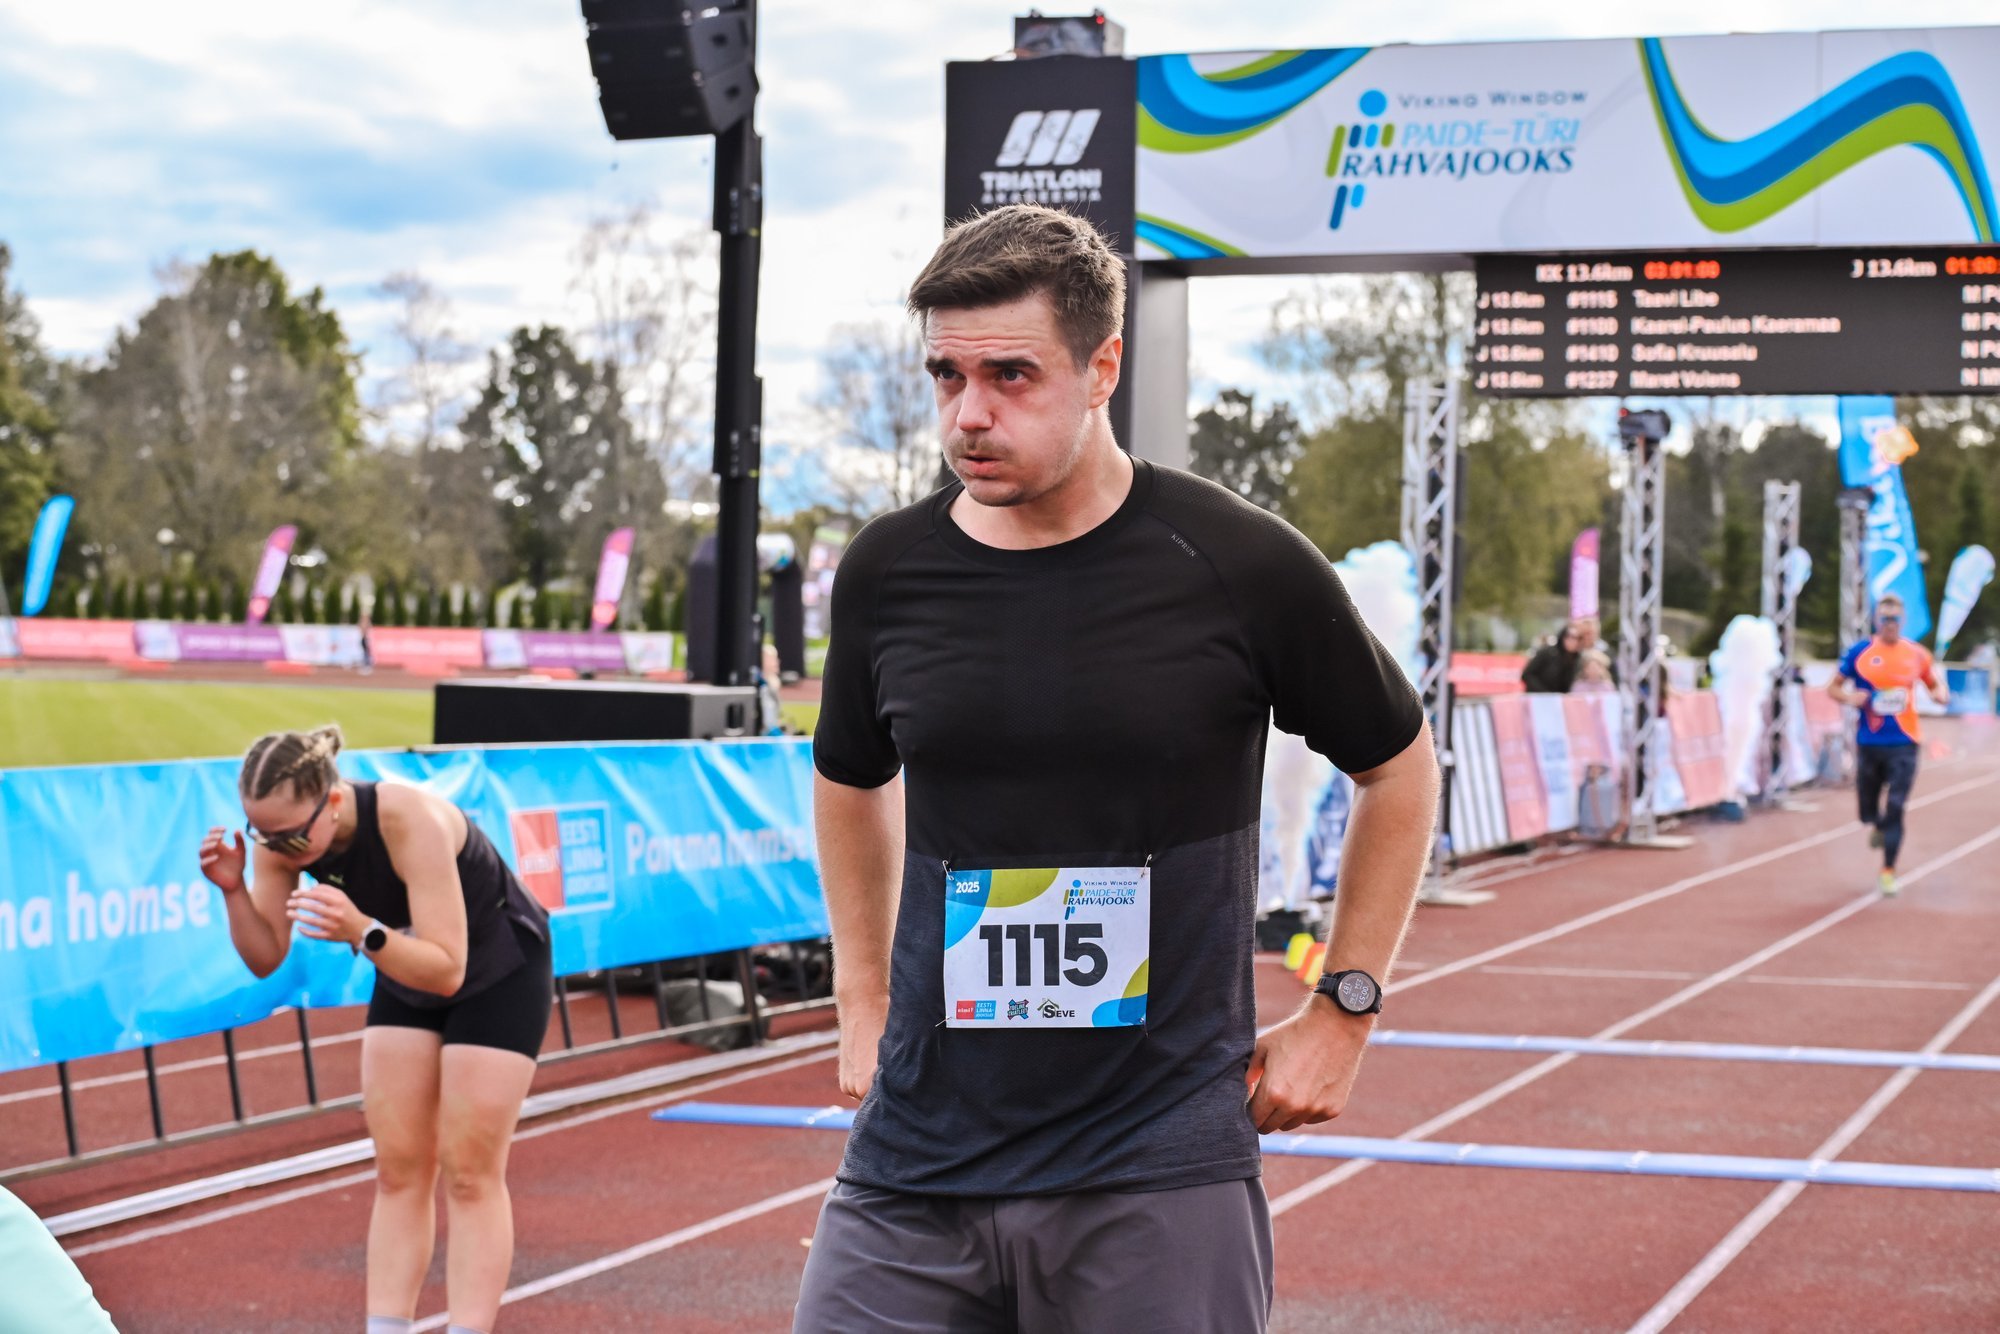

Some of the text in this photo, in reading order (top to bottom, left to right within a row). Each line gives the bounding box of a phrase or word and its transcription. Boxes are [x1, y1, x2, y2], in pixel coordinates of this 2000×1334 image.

[1342, 146, 1575, 181] RAHVAJOOKS
[980, 169, 1102, 191] TRIATLONI
[1171, 533, 1197, 557] KIPRUN
[956, 881, 980, 894] 2025
[67, 871, 210, 943] homse
[1068, 897, 1135, 906] RAHVAJOOKS
[979, 923, 1108, 987] 1115
[1043, 1004, 1076, 1018] SEVE
